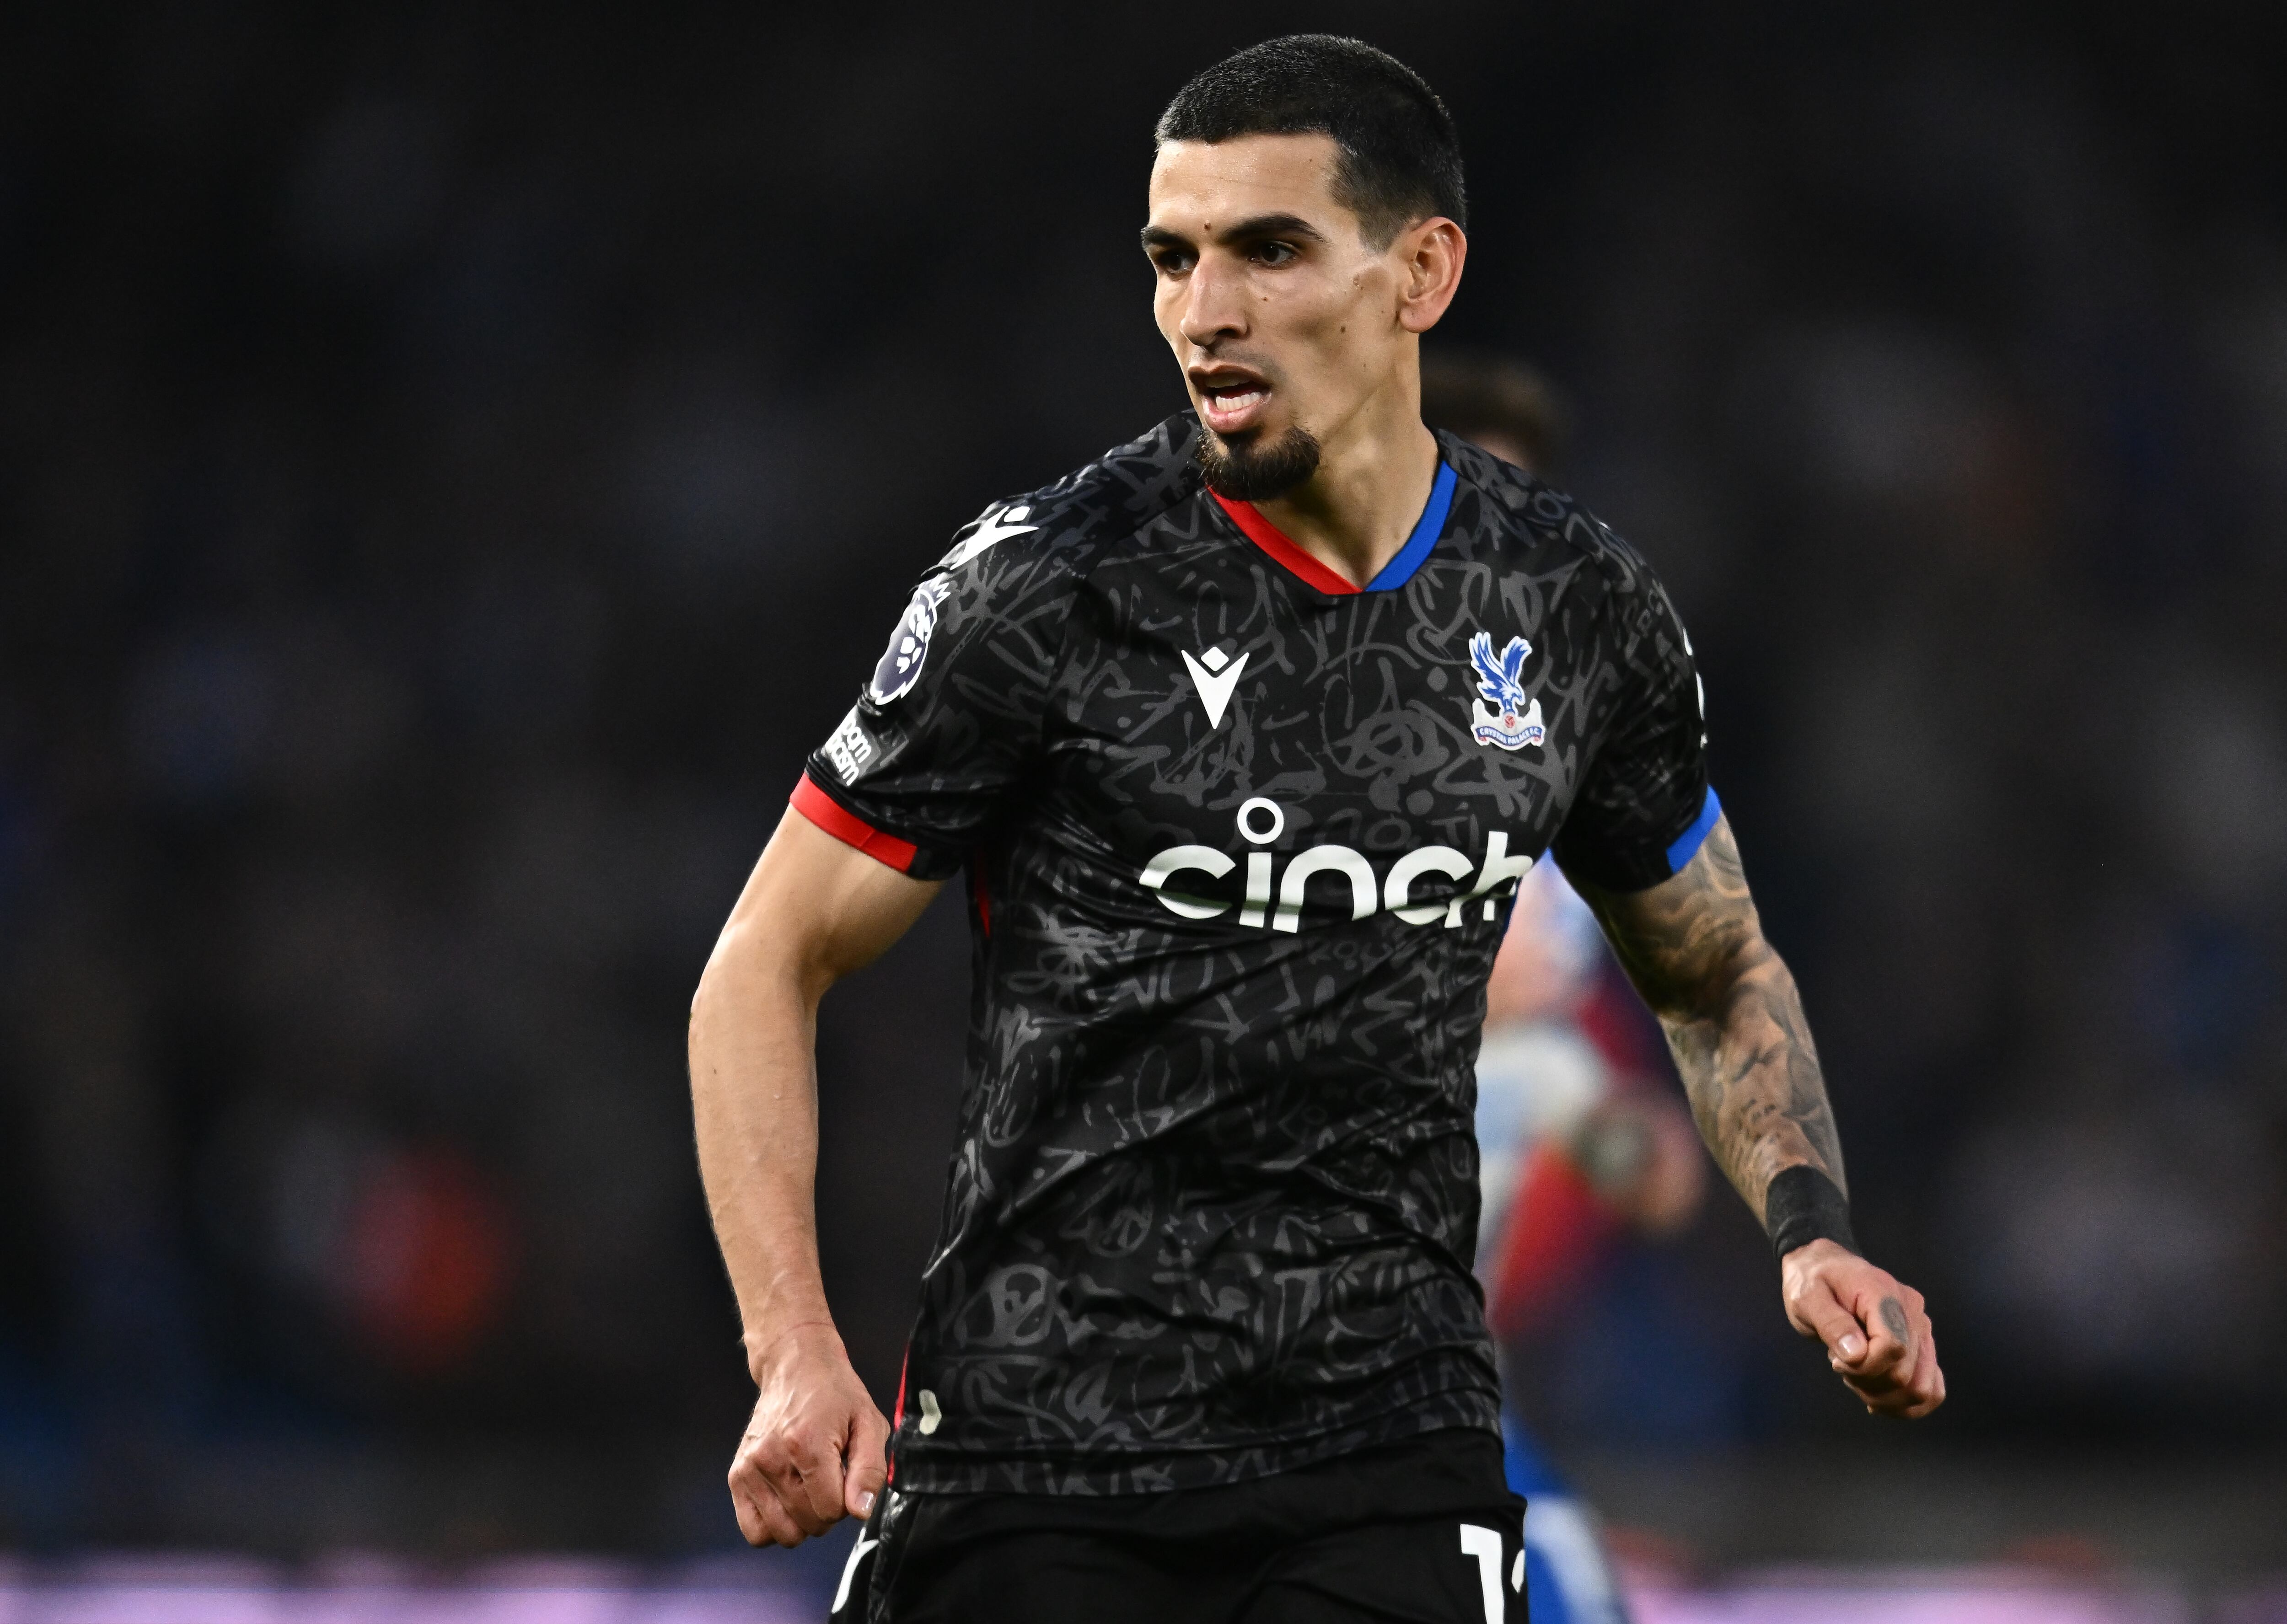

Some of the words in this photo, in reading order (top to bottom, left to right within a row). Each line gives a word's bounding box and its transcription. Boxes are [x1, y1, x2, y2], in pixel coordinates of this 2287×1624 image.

[1479, 728, 1508, 744] CRYSTAL
[1508, 730, 1530, 745] PALACE
[1139, 797, 1533, 933] cinch
[1460, 1524, 1525, 1624] 1
